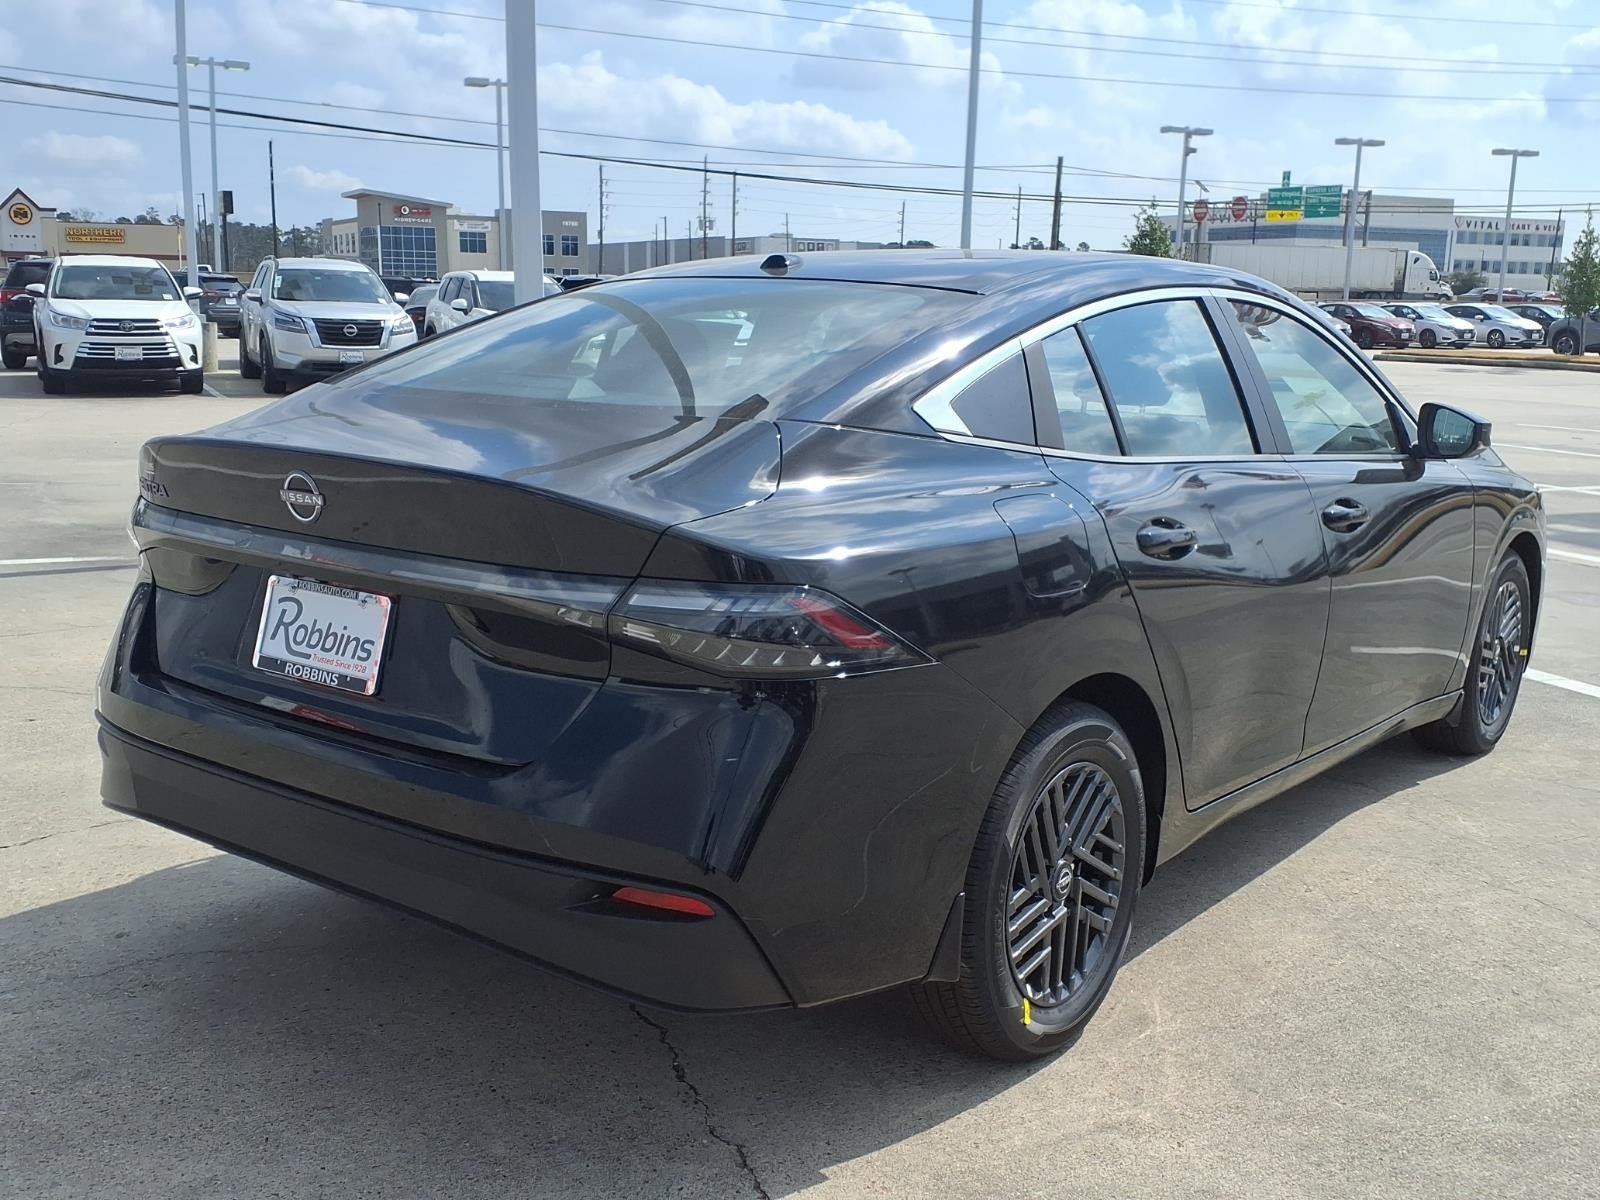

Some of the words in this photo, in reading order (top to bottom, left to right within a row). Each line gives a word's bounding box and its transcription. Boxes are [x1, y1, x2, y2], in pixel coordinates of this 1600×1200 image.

[65, 227, 125, 237] NORTHERN
[1466, 220, 1500, 230] VITAL
[1508, 223, 1531, 231] EART
[280, 489, 322, 505] NISSAN
[270, 596, 376, 662] Robbins
[312, 653, 335, 666] Trusted
[335, 659, 351, 669] Since
[351, 664, 367, 674] 1928
[284, 662, 339, 686] ROBBINS
